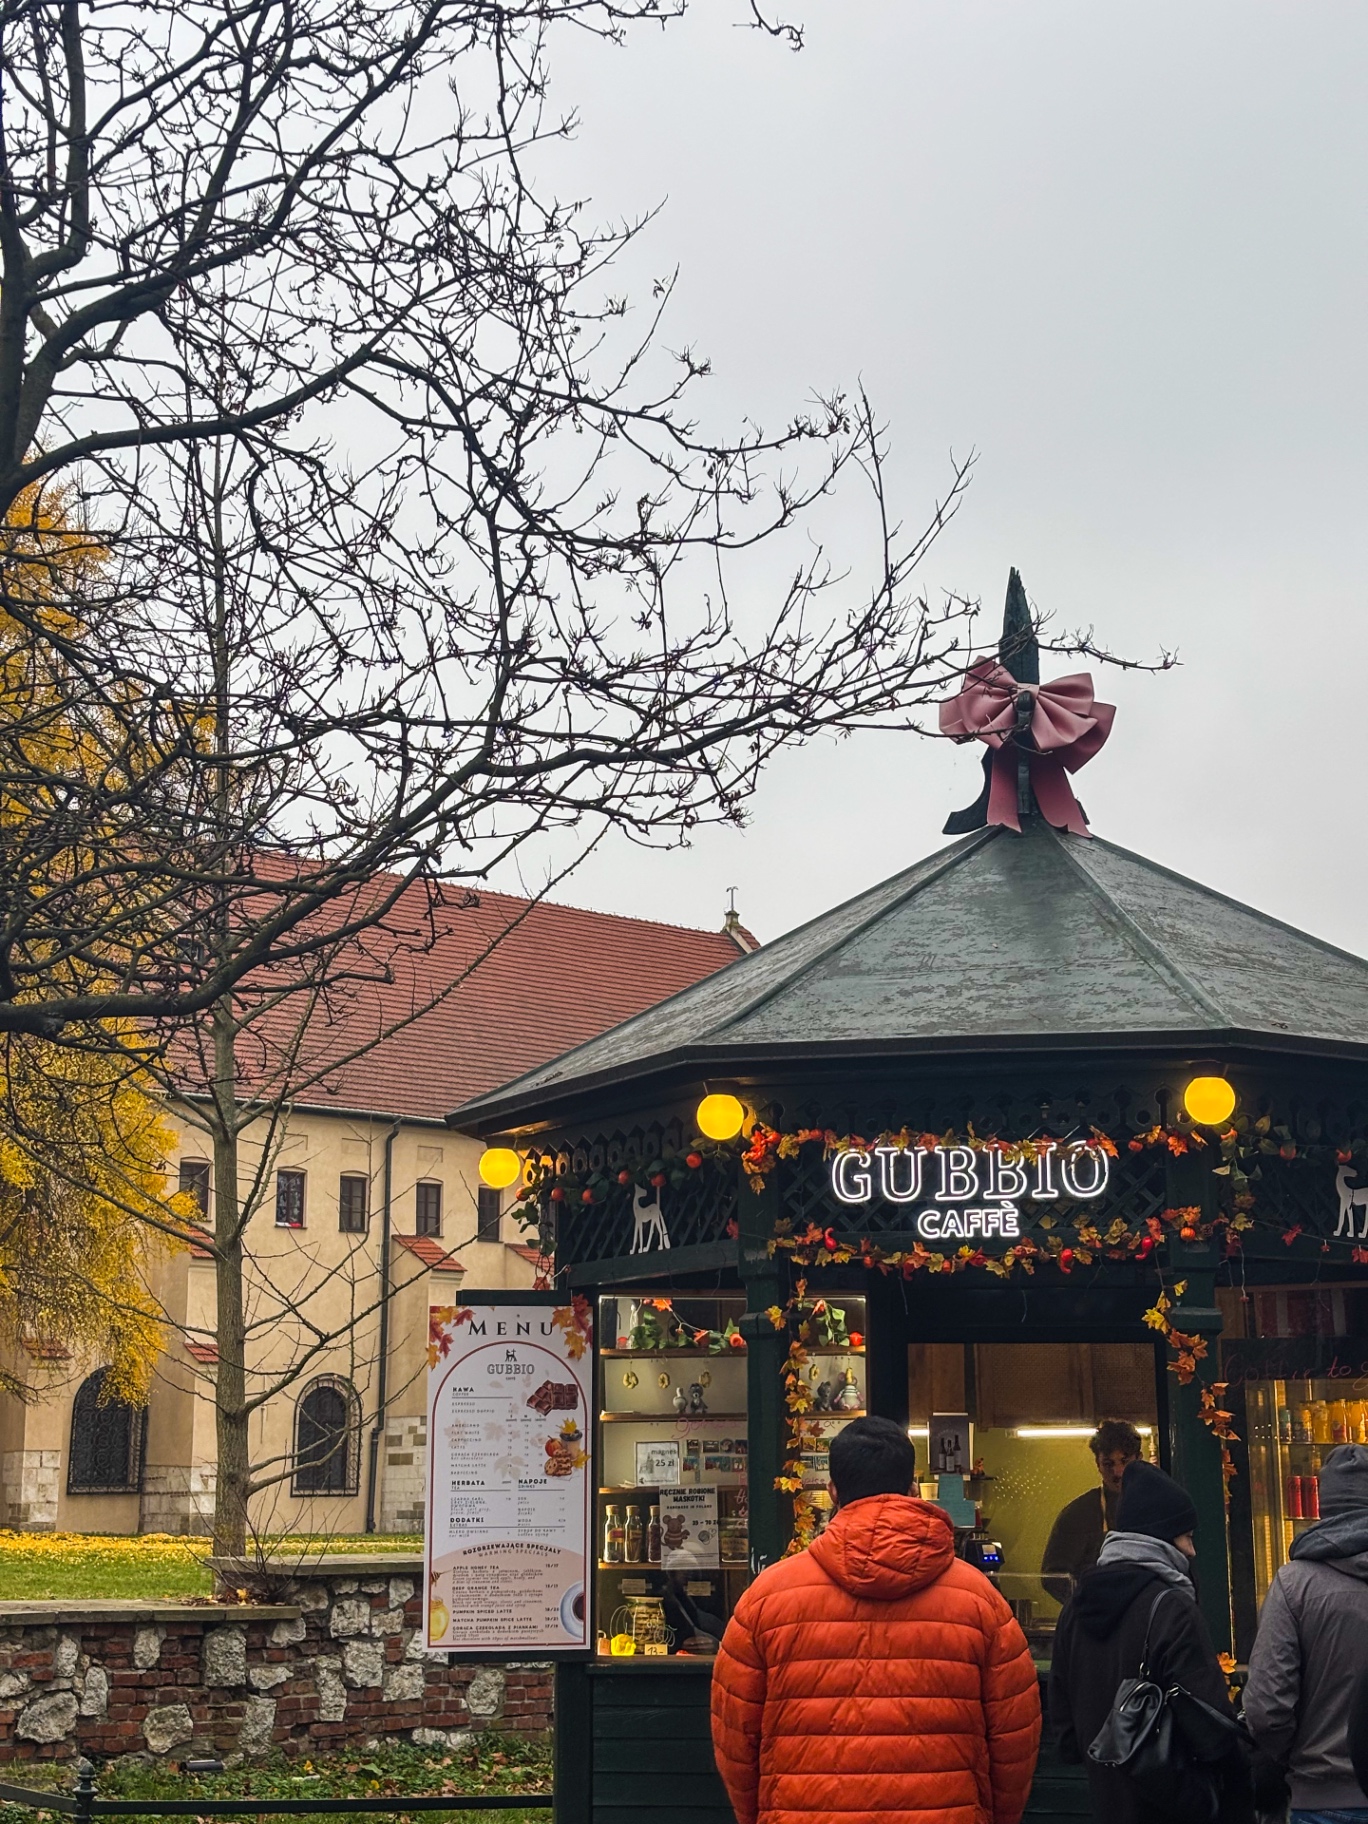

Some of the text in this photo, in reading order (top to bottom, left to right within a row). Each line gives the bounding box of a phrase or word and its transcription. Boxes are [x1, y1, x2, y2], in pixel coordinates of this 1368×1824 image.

[831, 1140, 1109, 1203] GUBBIO
[917, 1201, 1020, 1239] CAFFÈ
[468, 1319, 553, 1336] MENU
[486, 1363, 535, 1375] GUBBIO
[1326, 1355, 1352, 1378] to
[668, 1458, 674, 1466] zł
